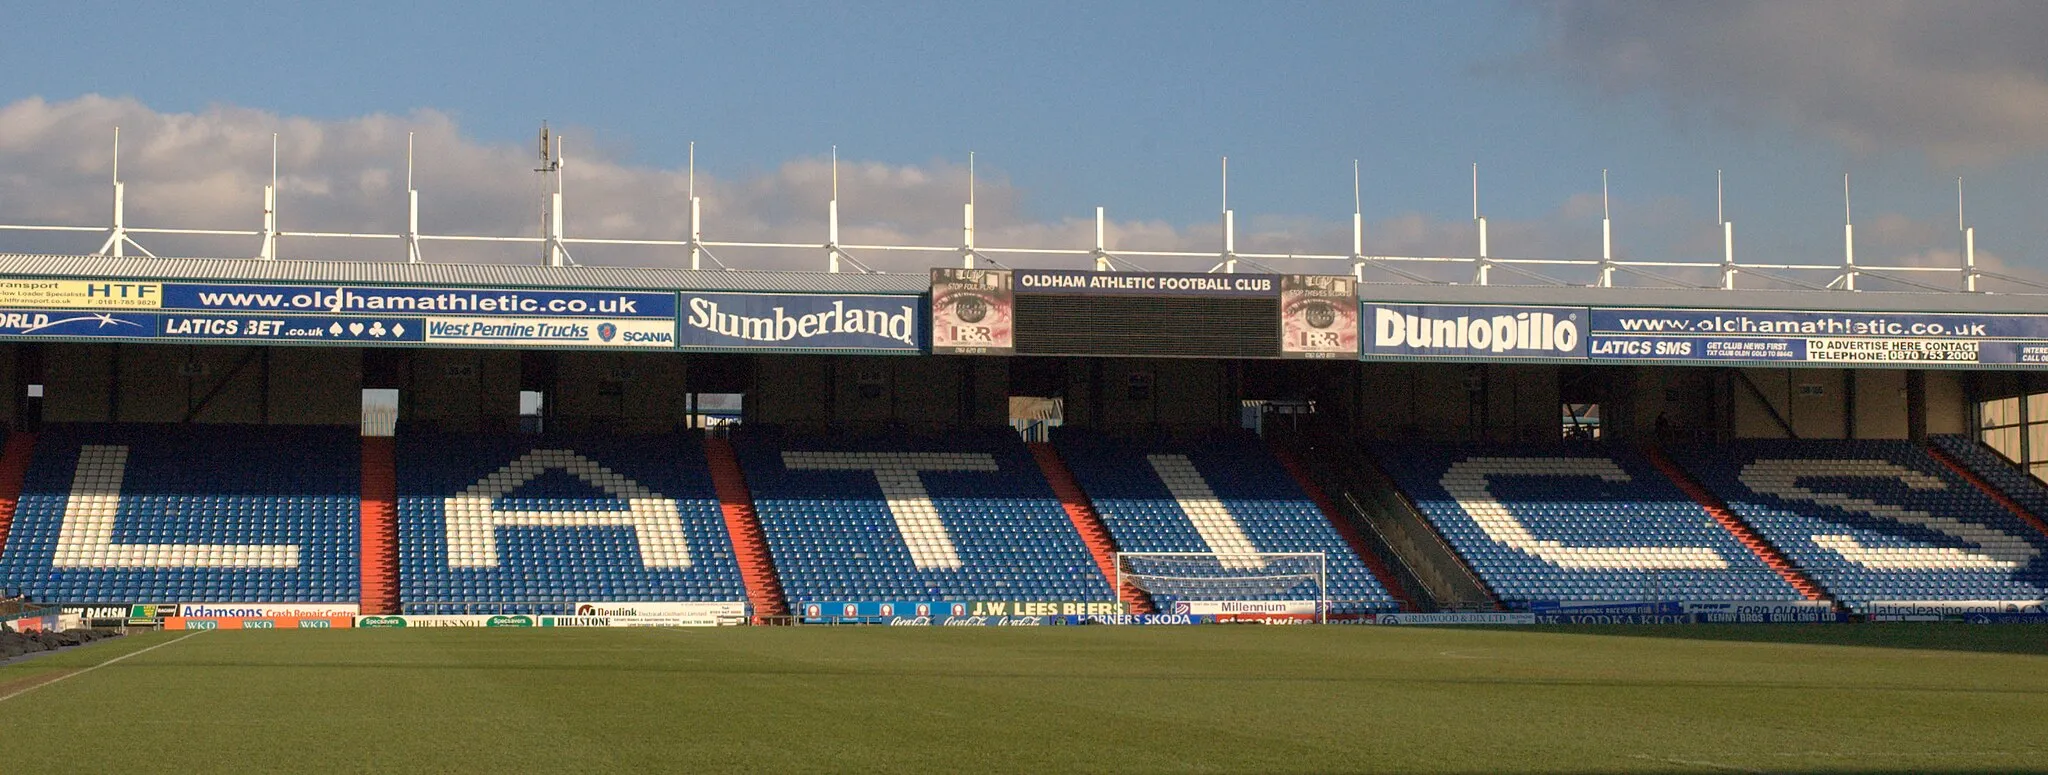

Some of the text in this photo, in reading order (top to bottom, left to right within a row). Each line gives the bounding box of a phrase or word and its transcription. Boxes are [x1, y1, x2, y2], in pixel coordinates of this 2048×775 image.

[1022, 275, 1271, 291] OLDHAM ATHLETIC FOOTBALL CLUB
[87, 283, 157, 298] HTF
[199, 290, 637, 314] www.oldhamathletic.co.uk
[166, 318, 239, 335] LATICS
[244, 319, 284, 336] BET
[688, 297, 914, 346] Slumberland
[430, 321, 589, 338] West Pennine Trucks
[1375, 307, 1578, 352] Dunlopillo
[623, 332, 673, 343] SCANIA
[1591, 341, 1692, 355] LATICS SMS
[1743, 342, 1765, 350] NEWS
[1809, 340, 1977, 351] TO ADVERTISE HERE CONTACT
[1810, 351, 1977, 360] TELEPHONE: 0870 753 2000
[2022, 354, 2040, 362] CALL
[86, 607, 126, 618] RACISM
[183, 606, 356, 617] Adamsons Crash Repair Centre
[973, 602, 1124, 616] J.W. LEES BEERS
[1221, 602, 1287, 612] Millennium
[1736, 606, 1769, 614] FORD
[1773, 606, 1828, 614] OLDHAM
[1874, 603, 1997, 614] laticsleasingcom
[366, 618, 399, 626] Specsavers
[494, 617, 526, 625] Specsavers
[557, 617, 611, 627] HILLSTONE
[1144, 614, 1192, 625] SKODA
[1404, 614, 1460, 623] GRIMWOOD
[1461, 614, 1468, 623] &
[1468, 614, 1486, 623] DIX
[1488, 614, 1507, 623] LTD
[1570, 615, 1635, 624] VODKA
[1641, 615, 1686, 624] KICK
[1707, 613, 1737, 622] KENNY
[1740, 613, 1764, 622] BROS
[1821, 613, 1837, 622] LTD
[187, 621, 216, 629] WKD
[243, 621, 273, 629] WKD
[300, 620, 329, 629] WKD
